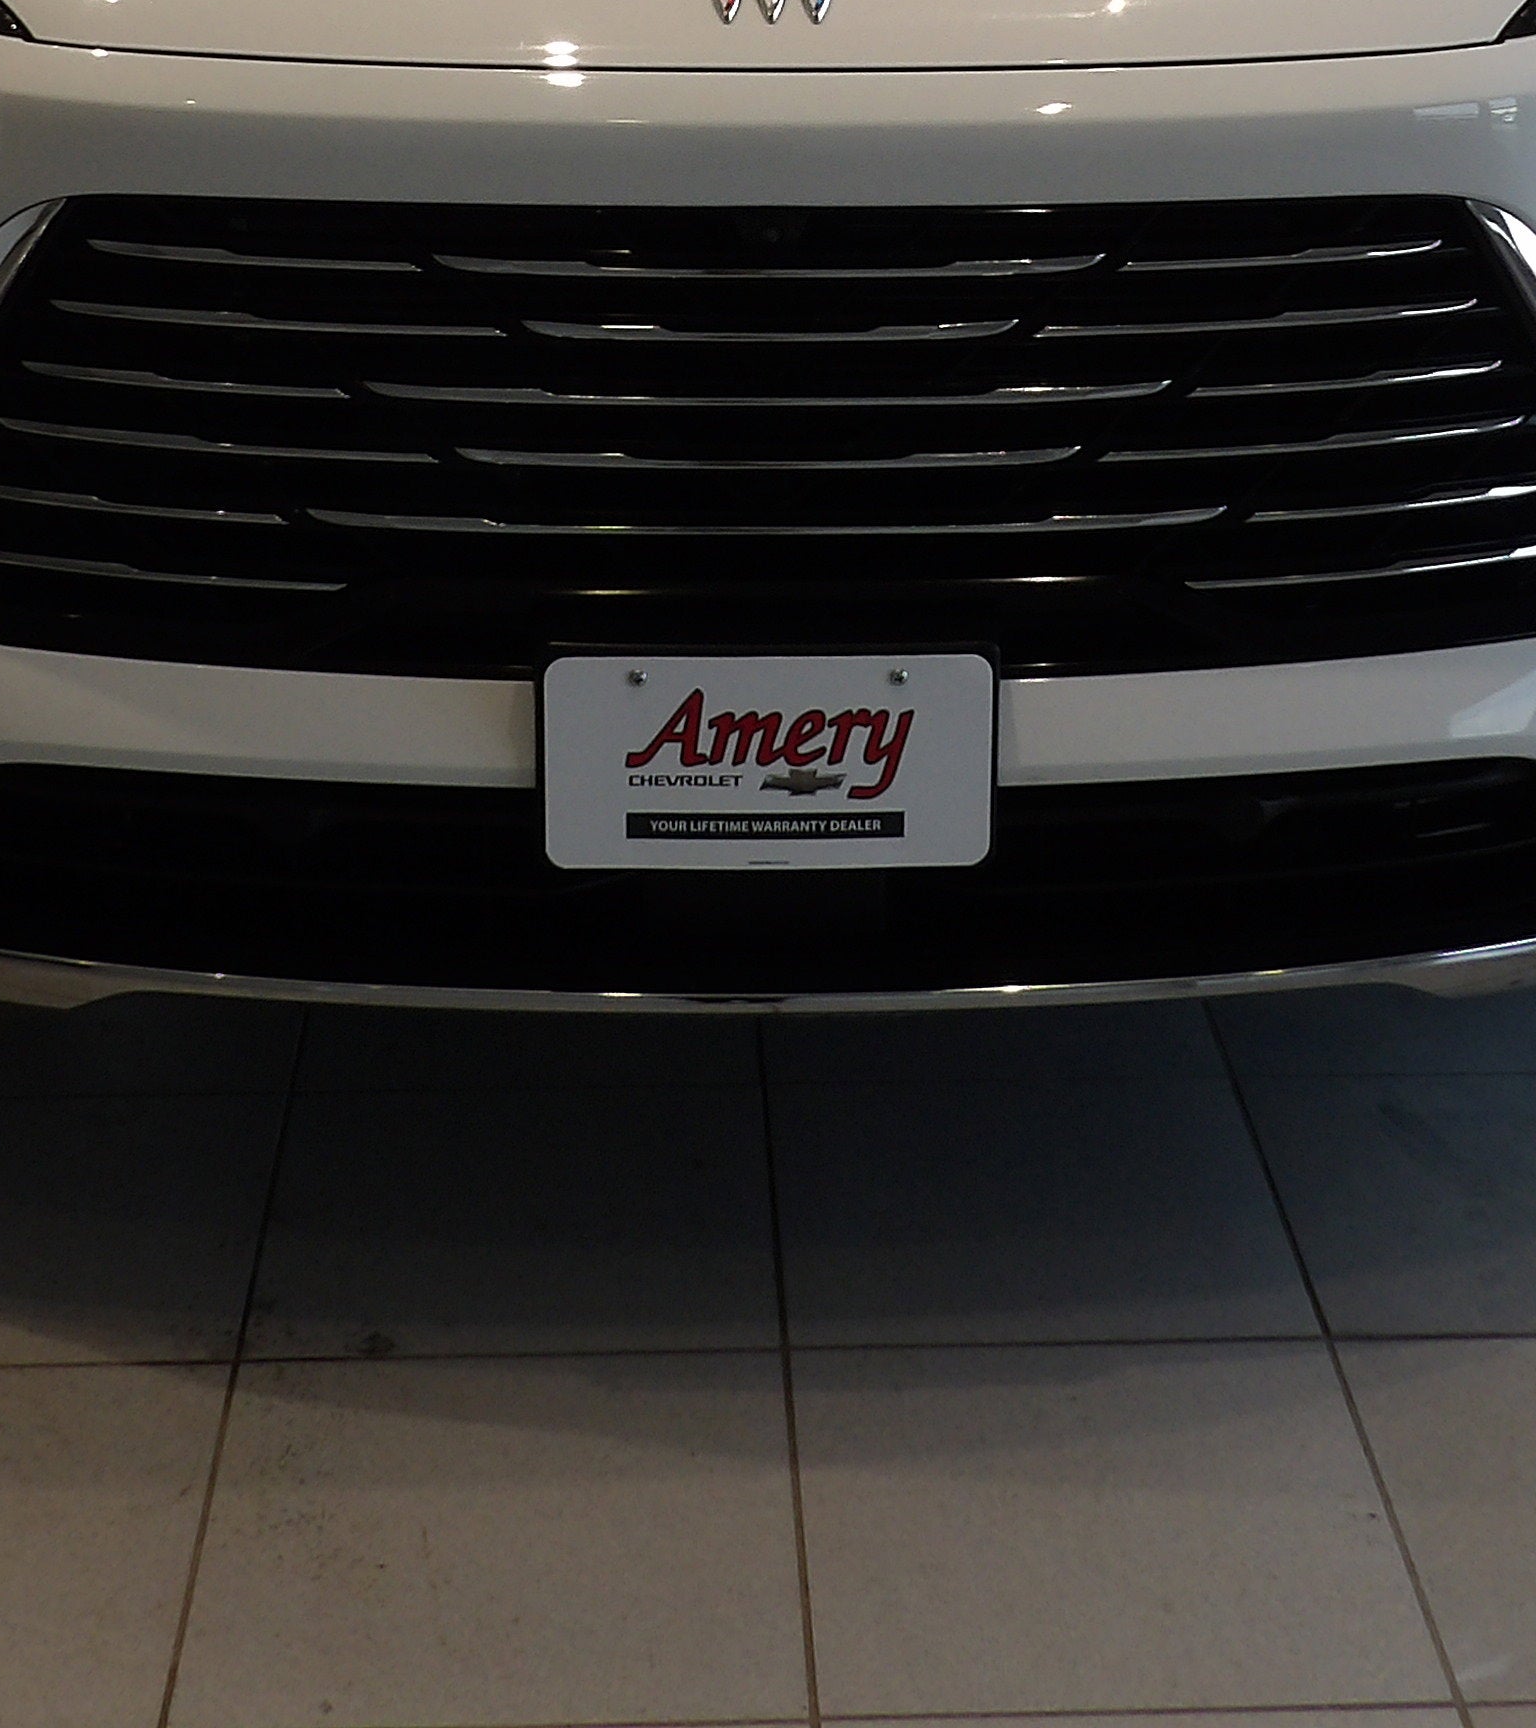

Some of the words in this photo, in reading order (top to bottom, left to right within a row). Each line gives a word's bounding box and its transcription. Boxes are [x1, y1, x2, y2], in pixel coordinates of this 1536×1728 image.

[626, 688, 914, 799] Amery
[628, 774, 743, 787] CHEVROLET
[650, 821, 687, 832] YOUR
[690, 821, 749, 833] LIFETIME
[751, 821, 826, 832] WARRANTY
[830, 820, 881, 832] DEALER
